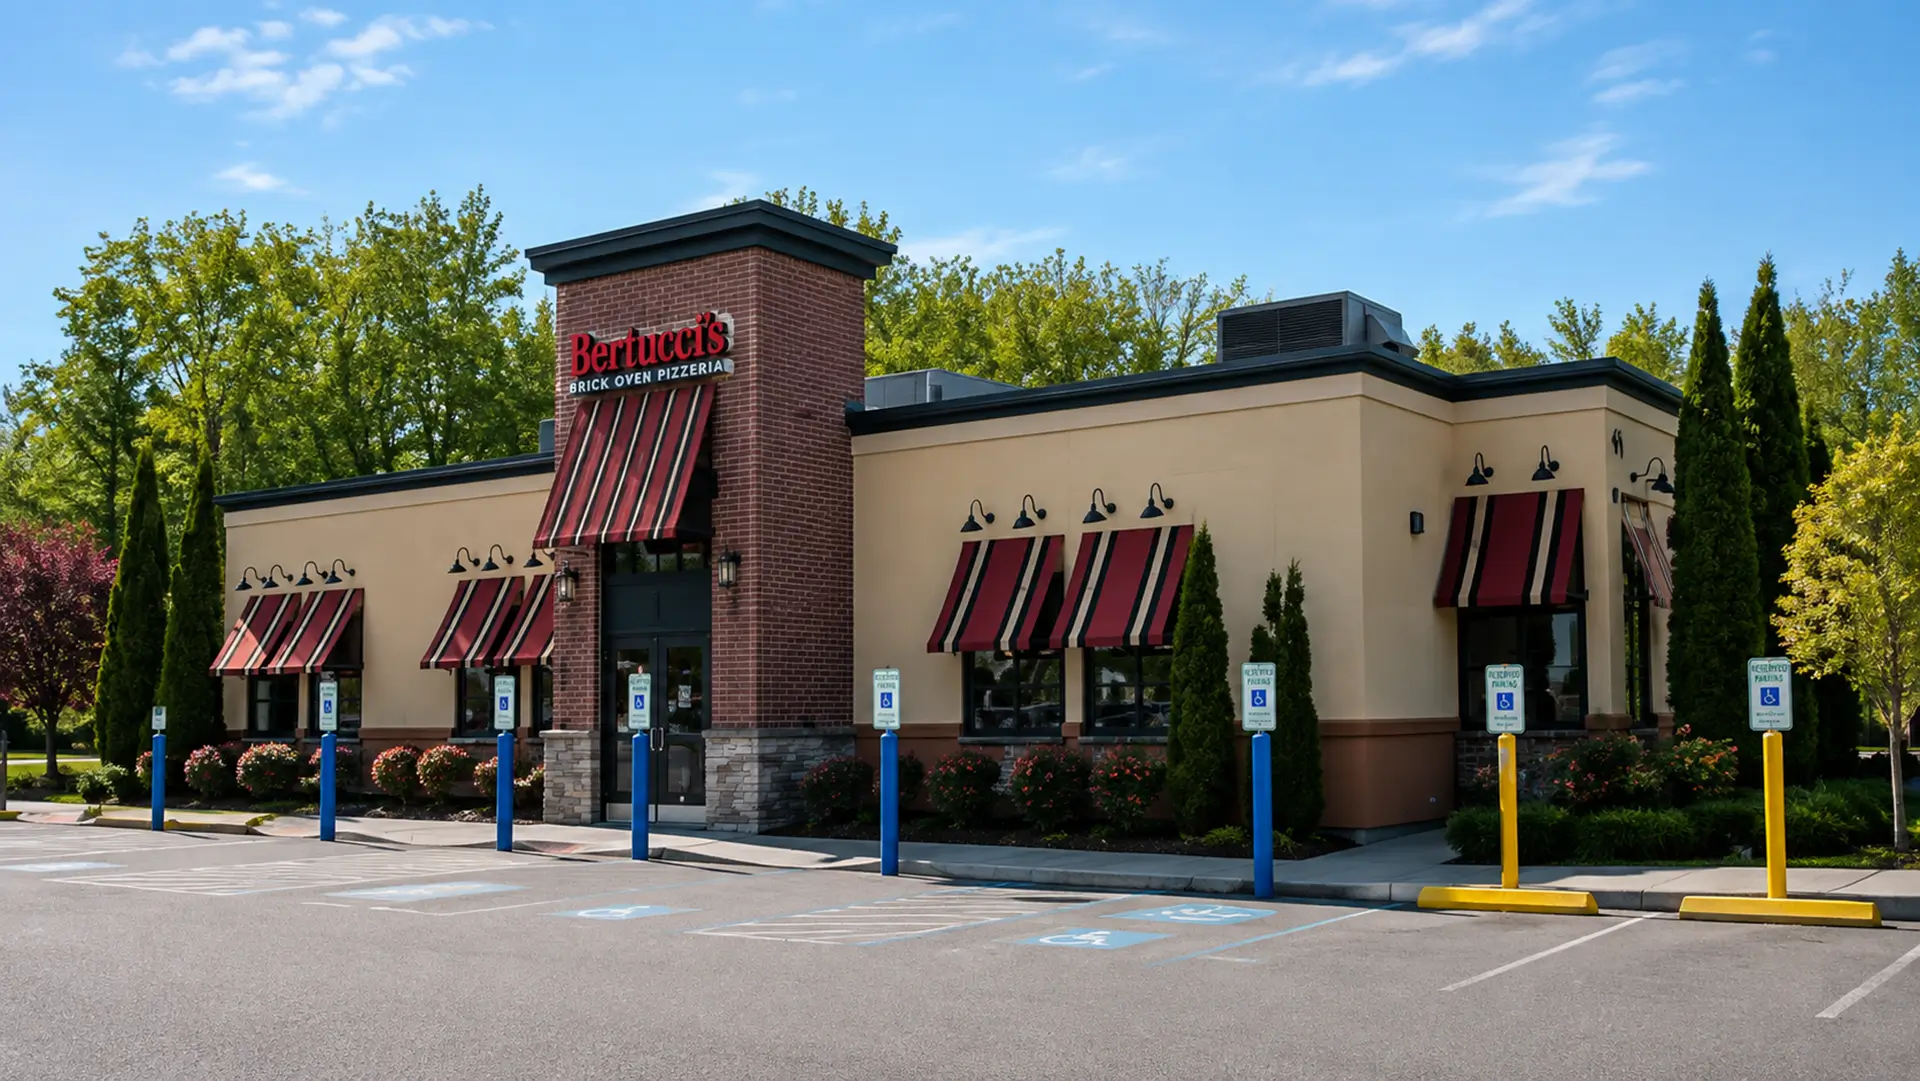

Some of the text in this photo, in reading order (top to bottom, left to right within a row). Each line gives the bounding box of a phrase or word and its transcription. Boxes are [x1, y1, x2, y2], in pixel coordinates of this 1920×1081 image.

[570, 311, 728, 377] Bertucci's
[569, 360, 723, 394] BRICK OVEN PIZZERIA
